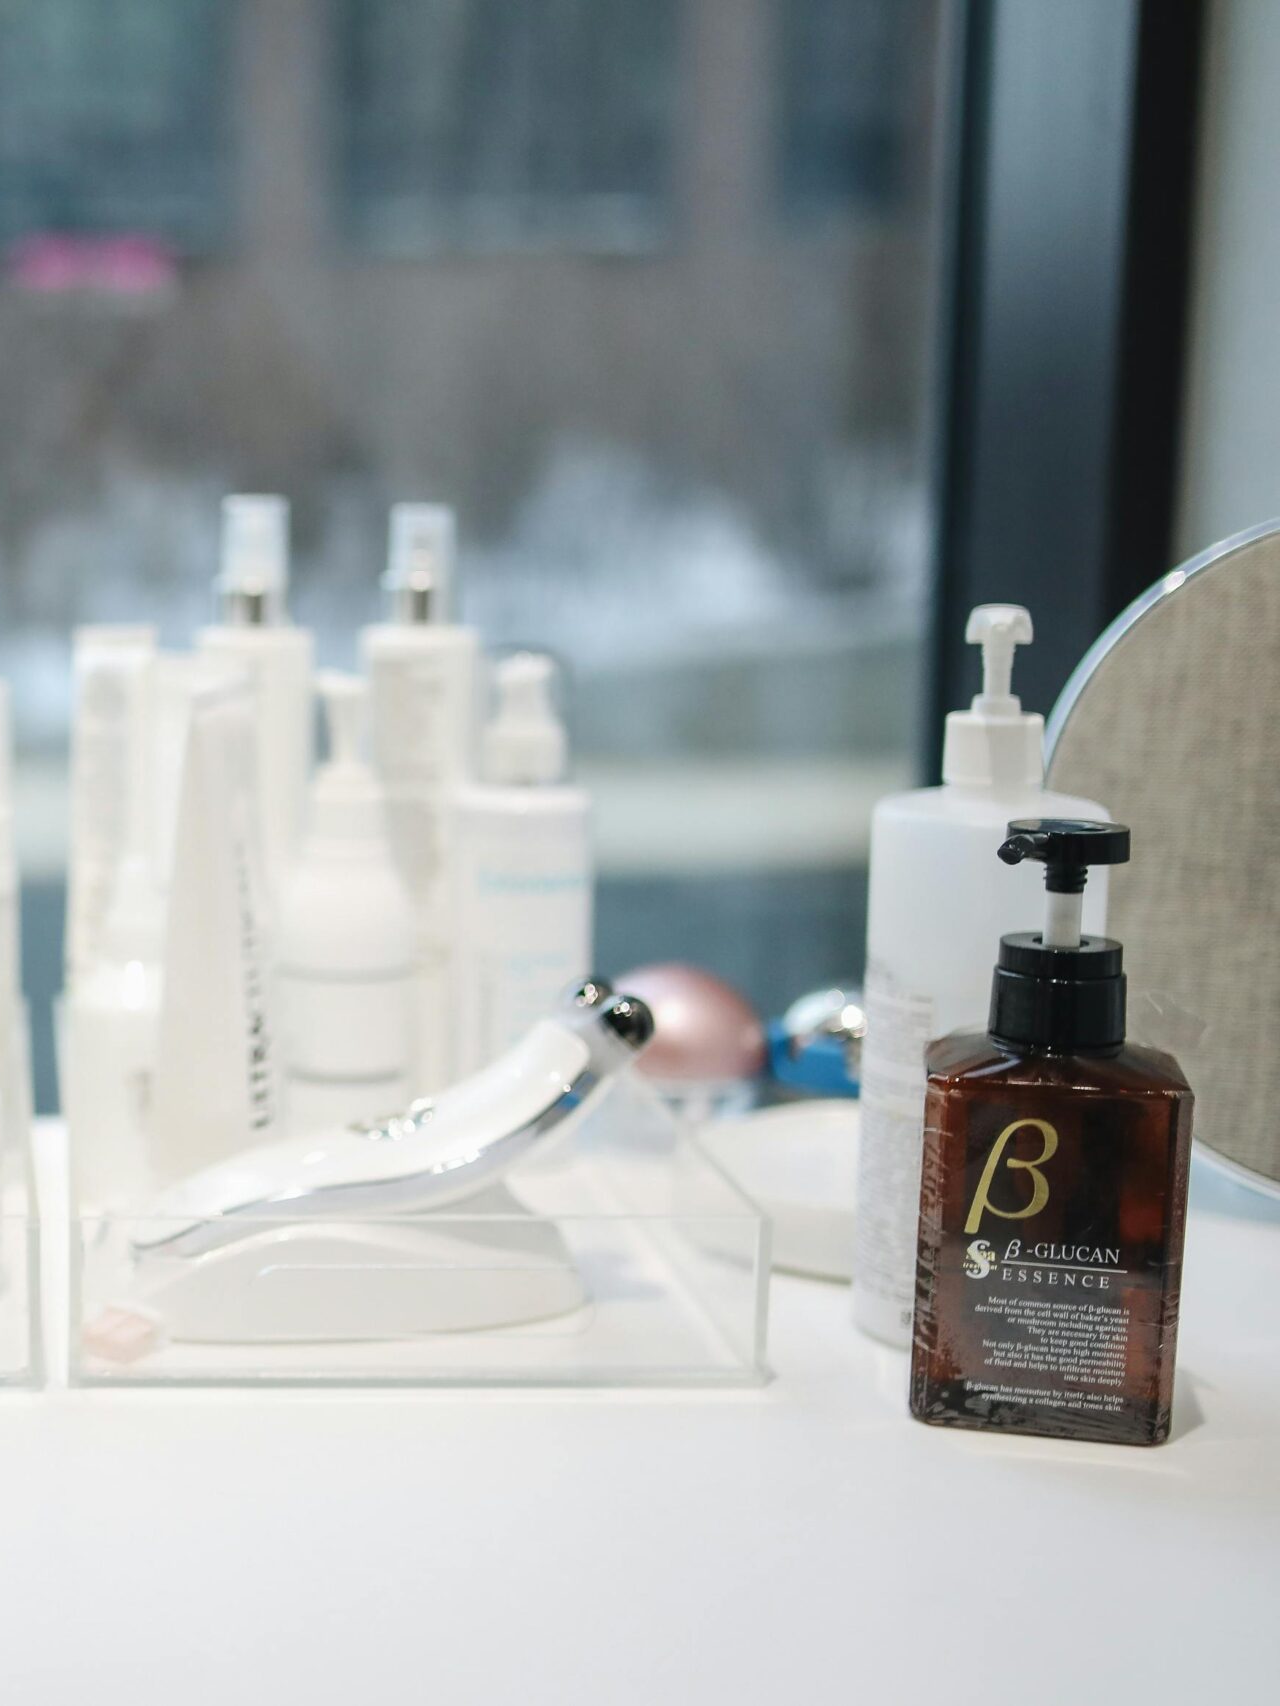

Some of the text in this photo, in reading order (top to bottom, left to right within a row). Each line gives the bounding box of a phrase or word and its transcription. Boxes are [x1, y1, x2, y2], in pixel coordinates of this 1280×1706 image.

[964, 1119, 1058, 1234] β
[1002, 1268, 1110, 1289] ESSENCE
[974, 1303, 1002, 1313] derived
[1004, 1306, 1022, 1315] from
[1023, 1308, 1035, 1316] the
[1037, 1310, 1050, 1318] cell
[1052, 1311, 1068, 1319] wall
[1109, 1317, 1128, 1325] yeast
[988, 1296, 1129, 1316] Most of common source of β-glucan is
[1017, 1317, 1056, 1327] mushroom
[1058, 1320, 1093, 1332] including
[1027, 1325, 1045, 1336] They
[1061, 1330, 1097, 1341] necessary
[1099, 1332, 1109, 1340] for
[1111, 1333, 1128, 1342] skin
[982, 1339, 996, 1347] Not
[997, 1341, 1014, 1351] only
[1016, 1342, 1048, 1352] β-glucan
[1050, 1345, 1071, 1356] keeps
[1073, 1347, 1090, 1357] high
[1040, 1335, 1048, 1343] to
[1049, 1336, 1067, 1347] keep
[1069, 1339, 1088, 1347] good
[993, 1348, 1005, 1357] but
[1007, 1350, 1022, 1358] also
[1023, 1351, 1029, 1359] it
[1031, 1352, 1043, 1360] has
[1045, 1353, 1057, 1362] the
[1058, 1356, 1077, 1364] good
[984, 1357, 992, 1365] of
[994, 1357, 1011, 1366] fluid
[1013, 1360, 1027, 1368] and
[1028, 1361, 1048, 1371] helps
[1049, 1363, 1057, 1371] to
[1092, 1367, 1125, 1377] moisture
[1063, 1373, 1078, 1382] into
[1080, 1375, 1095, 1383] skin
[965, 1381, 998, 1392] β-glucan
[1000, 1384, 1012, 1393] has
[1052, 1389, 1062, 1399] by
[1086, 1393, 1102, 1401] also
[1103, 1394, 1123, 1405] helps
[1034, 1397, 1066, 1408] collagen
[1067, 1400, 1081, 1408] and
[1083, 1401, 1103, 1410] tones
